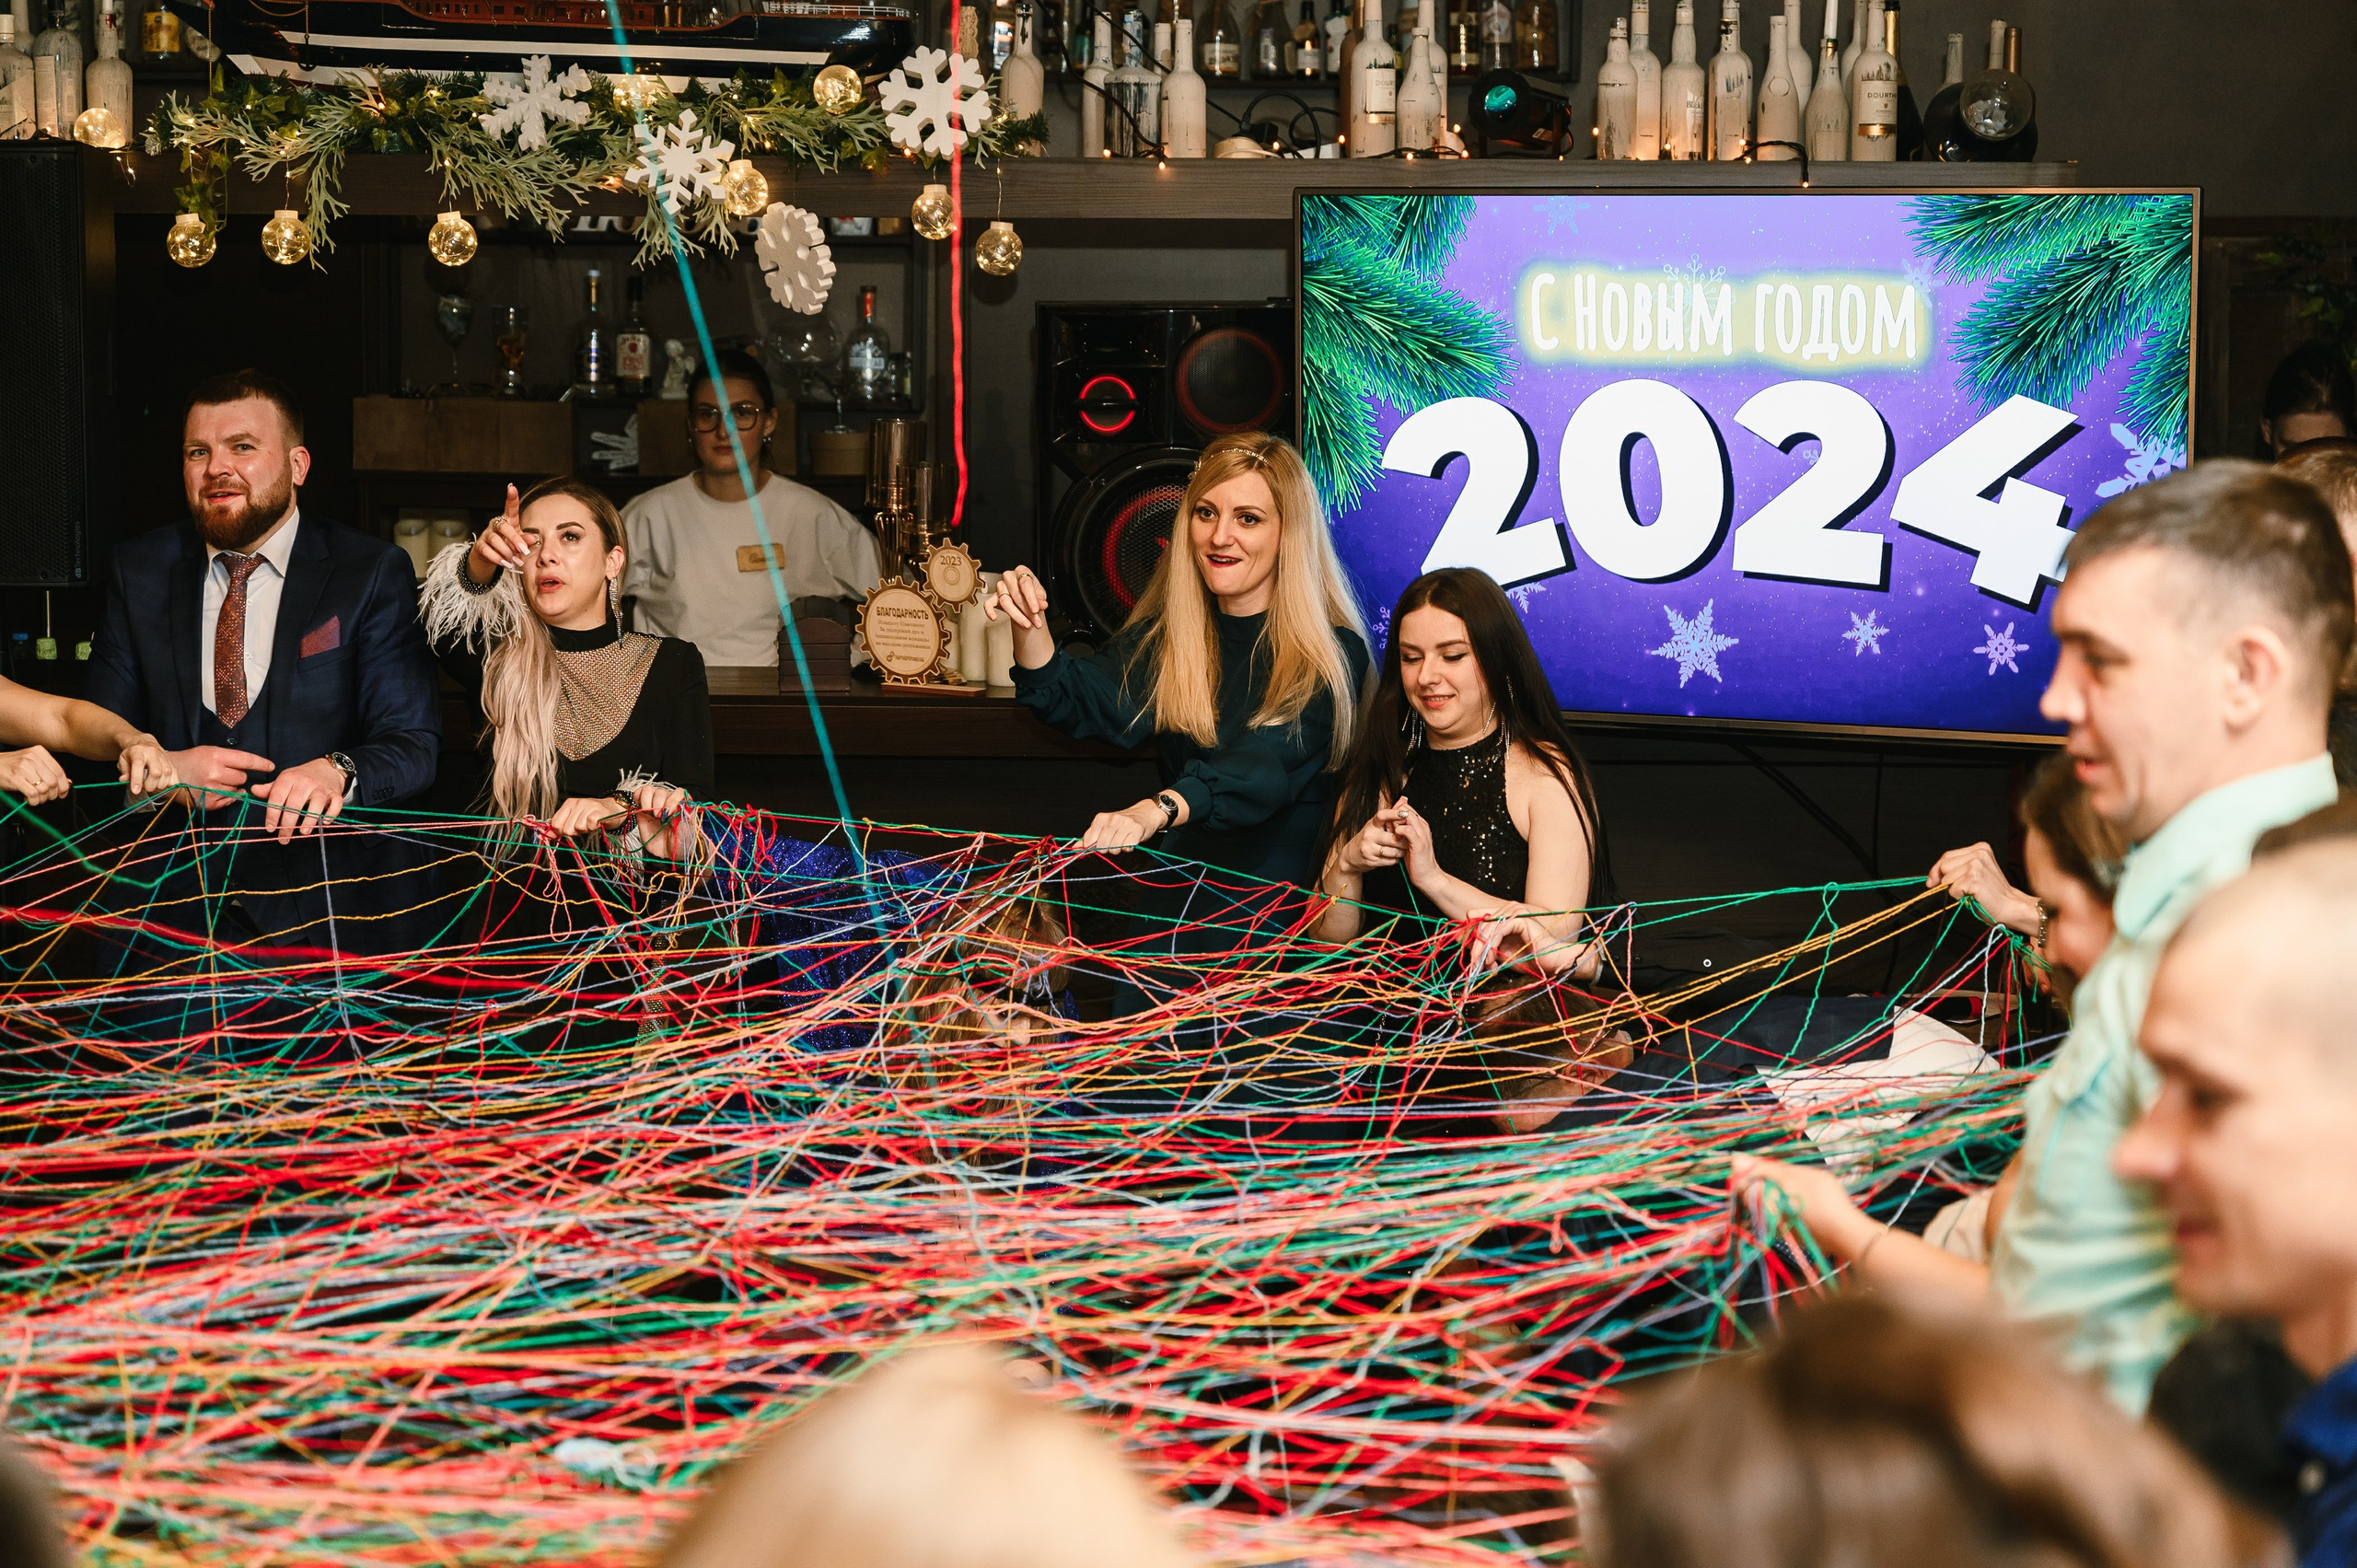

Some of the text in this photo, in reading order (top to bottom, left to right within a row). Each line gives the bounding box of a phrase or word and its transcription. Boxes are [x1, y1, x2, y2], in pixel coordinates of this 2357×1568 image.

[1531, 273, 1917, 362] С НОВЫМ ГОДОМ
[1381, 378, 2083, 608] 2024
[940, 555, 962, 566] 2023
[877, 607, 929, 620] БЛАГОДАРНОСТЬ
